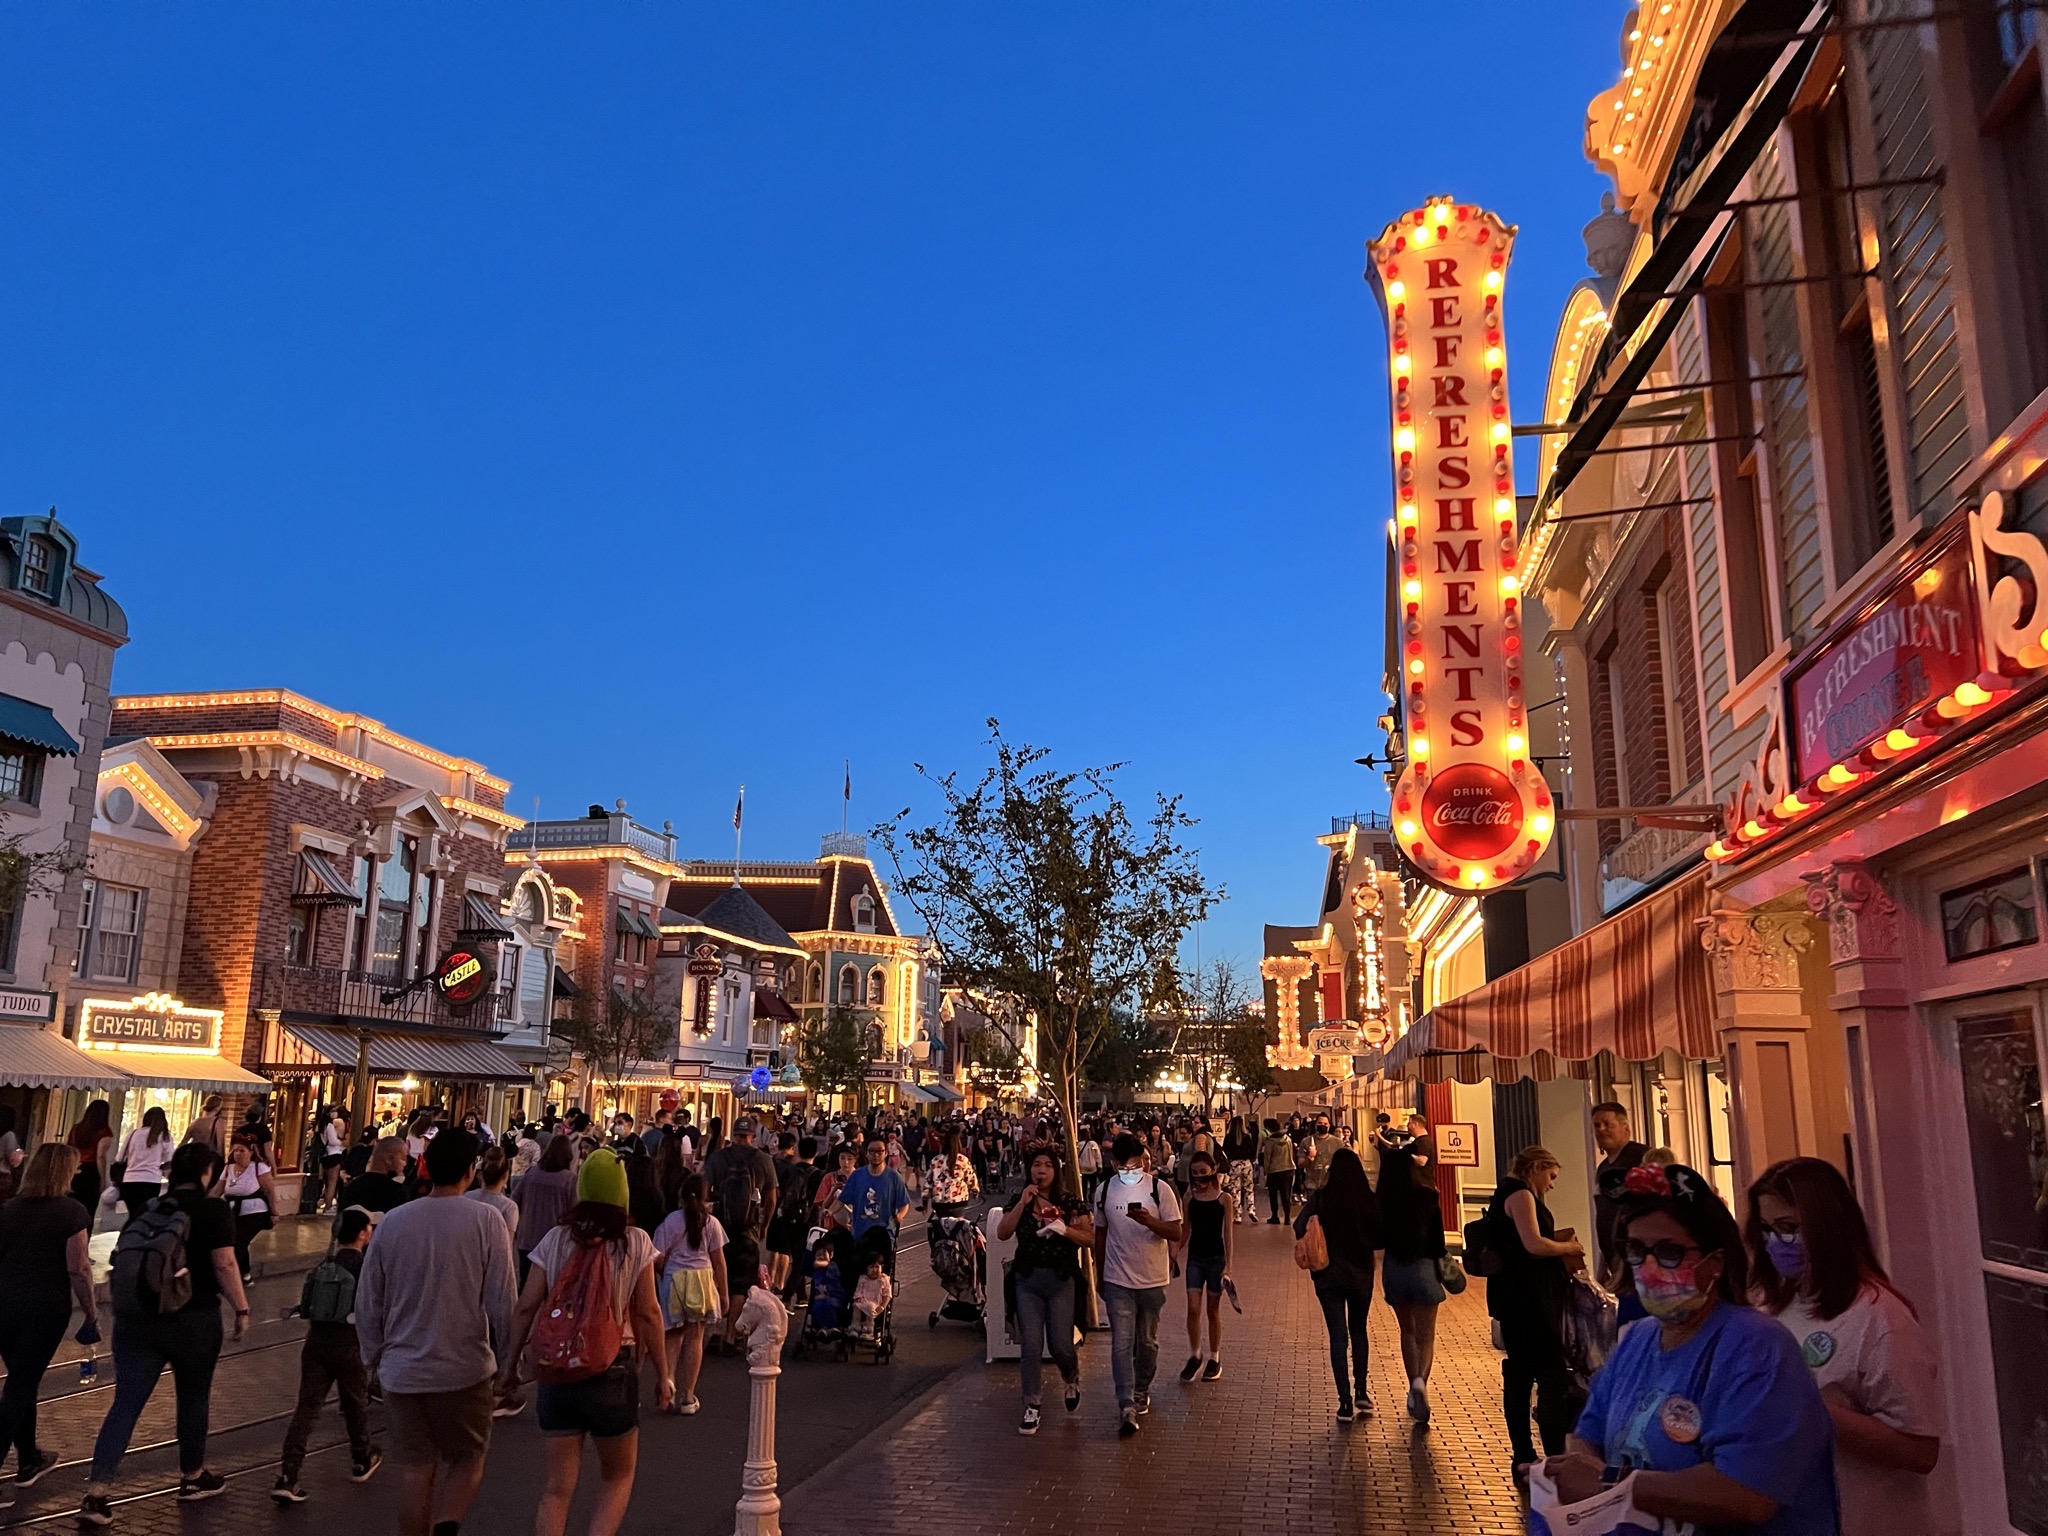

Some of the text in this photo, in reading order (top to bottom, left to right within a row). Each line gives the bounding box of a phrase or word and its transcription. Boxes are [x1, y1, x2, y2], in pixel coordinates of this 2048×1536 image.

[1424, 257, 1485, 748] REFRESHMENTS
[1803, 602, 1961, 759] REFRESHMENT
[1453, 787, 1493, 797] DRINK
[1433, 801, 1514, 827] Coca-Cola
[1363, 918, 1377, 952] ICE
[440, 960, 478, 991] CASTLE
[0, 995, 41, 1013] TUDIO
[903, 967, 913, 1039] MARKET HOUSE
[93, 1015, 202, 1040] CRYSTAL ARTS
[1316, 1037, 1368, 1052] ICE CRE
